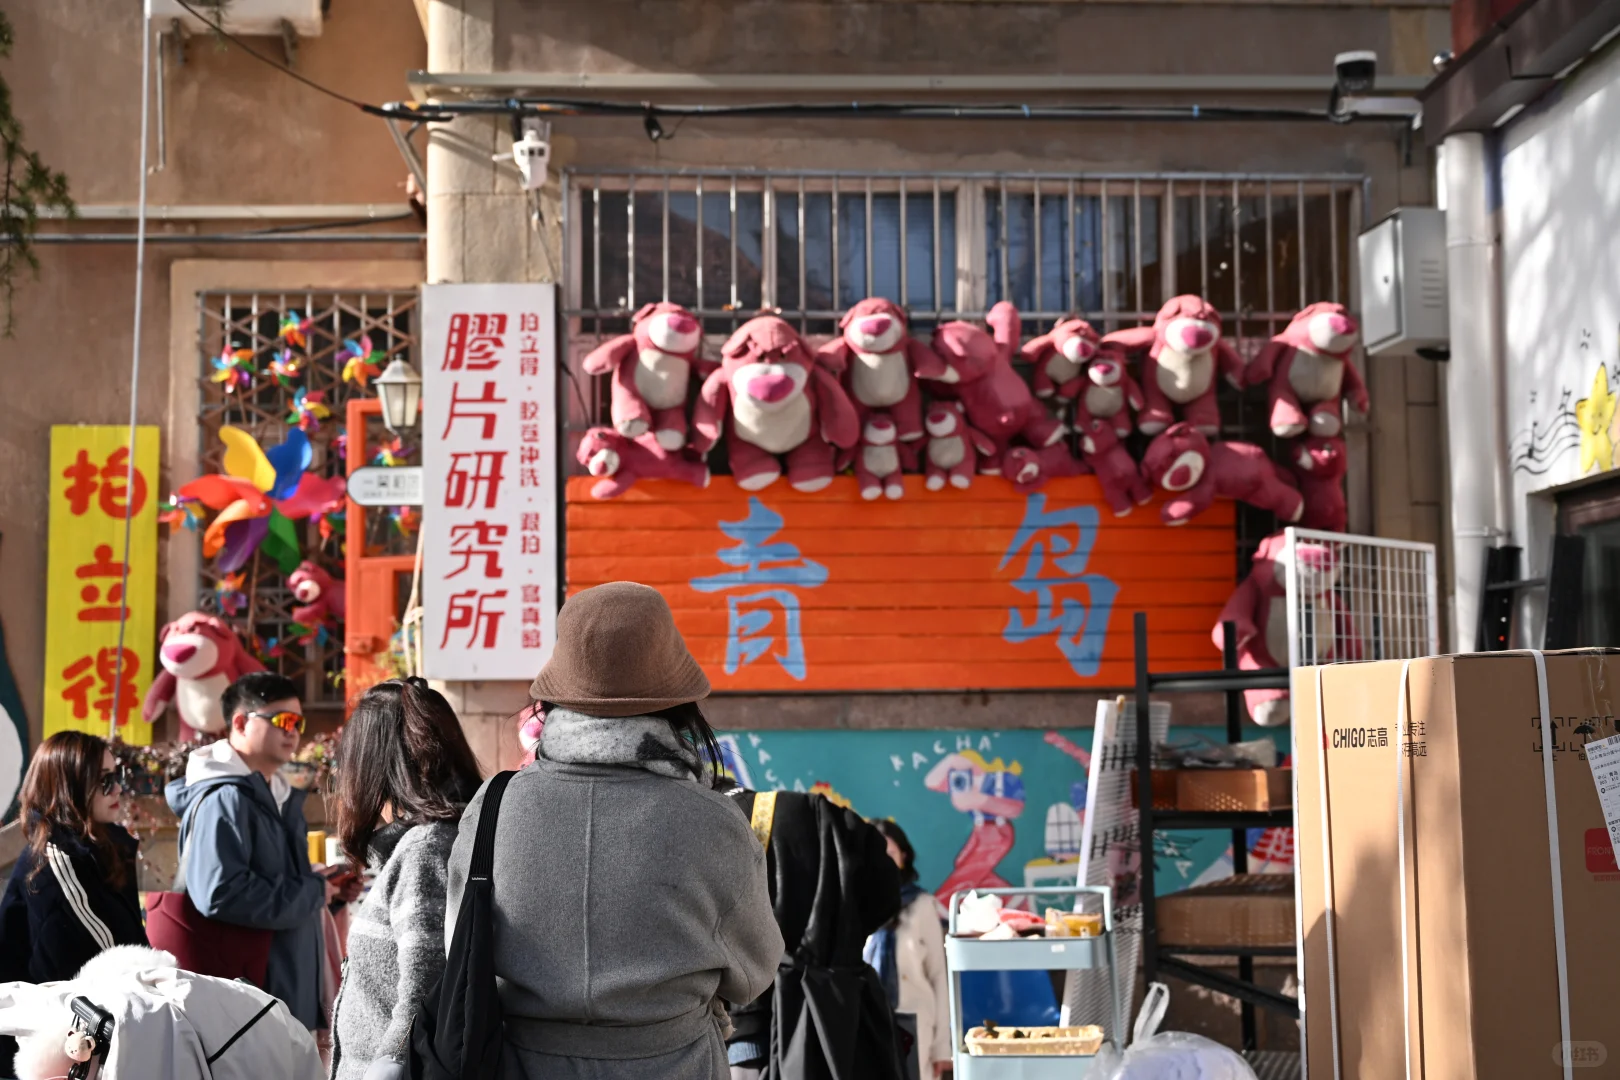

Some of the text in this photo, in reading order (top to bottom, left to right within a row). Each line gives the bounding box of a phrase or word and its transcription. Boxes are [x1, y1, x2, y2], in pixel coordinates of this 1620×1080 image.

[62, 446, 149, 727] 拍立得
[441, 313, 509, 649] 膠片研究所
